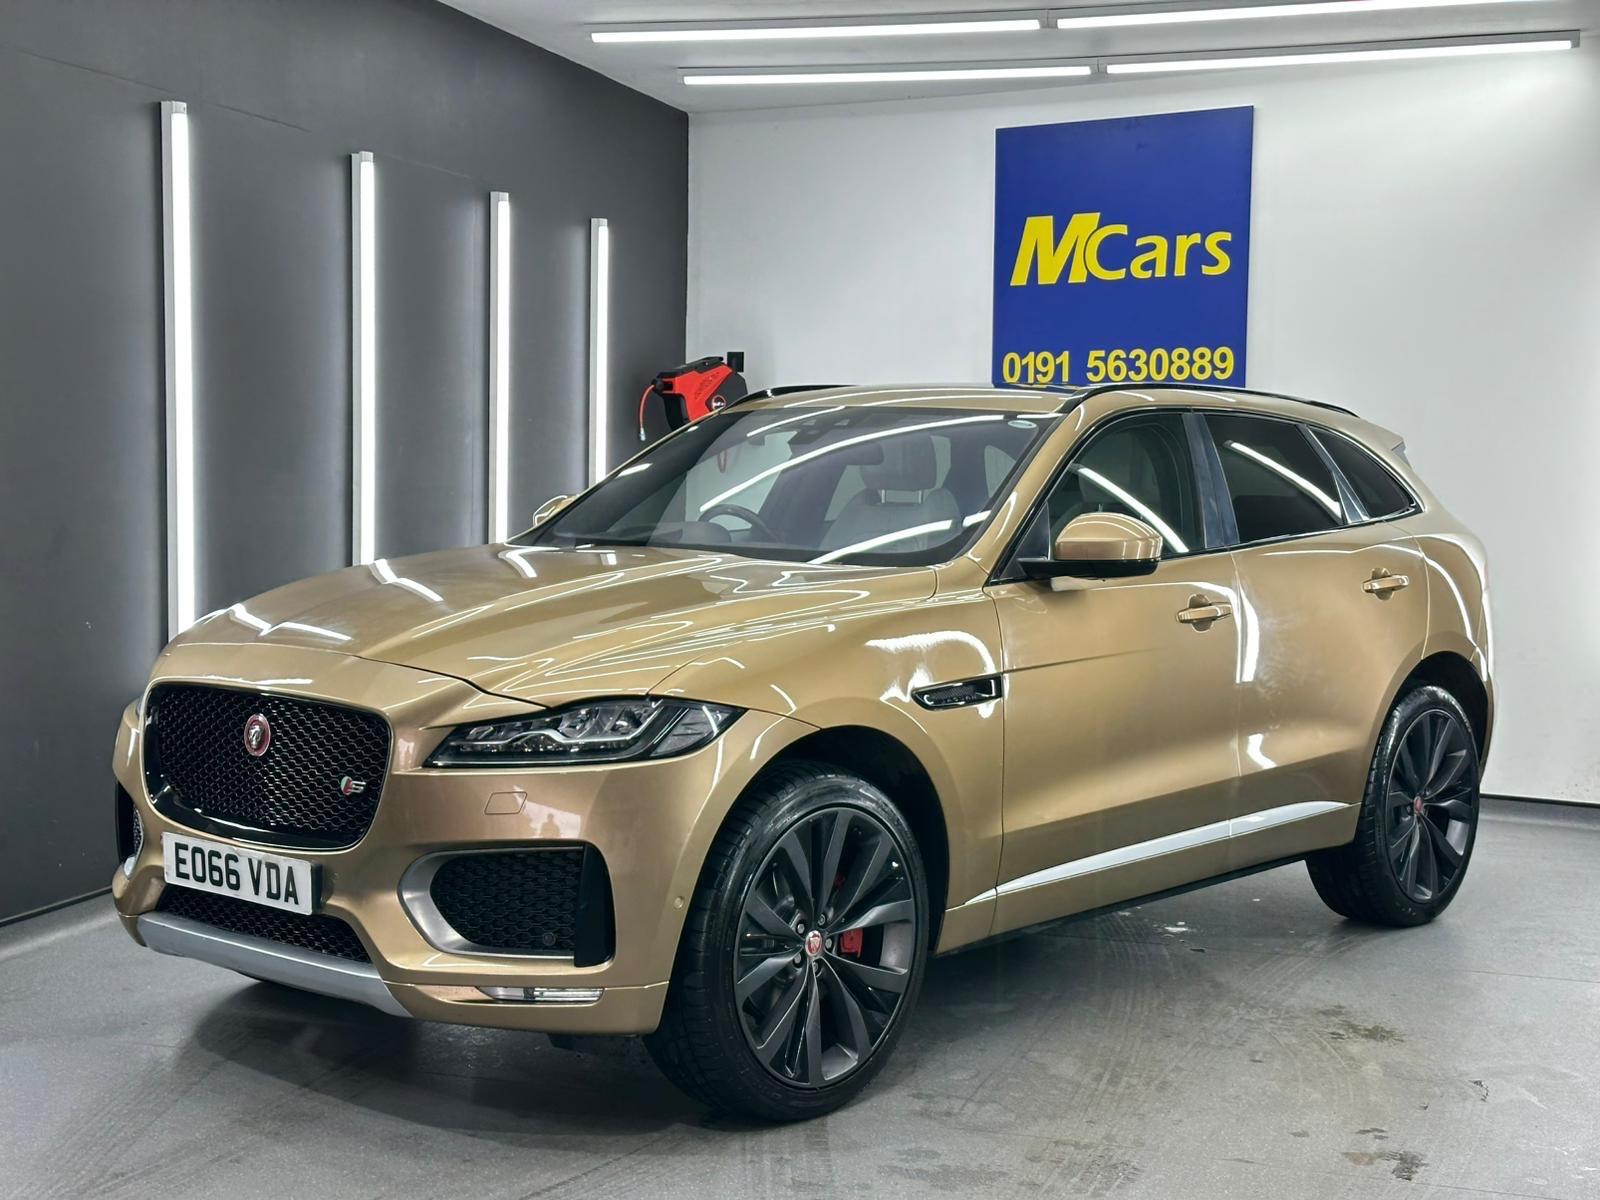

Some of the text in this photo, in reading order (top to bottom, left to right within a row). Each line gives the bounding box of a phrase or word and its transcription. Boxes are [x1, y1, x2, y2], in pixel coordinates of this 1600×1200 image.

[1009, 212, 1232, 286] MCars
[1002, 346, 1234, 384] 0191 5630889
[247, 857, 299, 905] VDA
